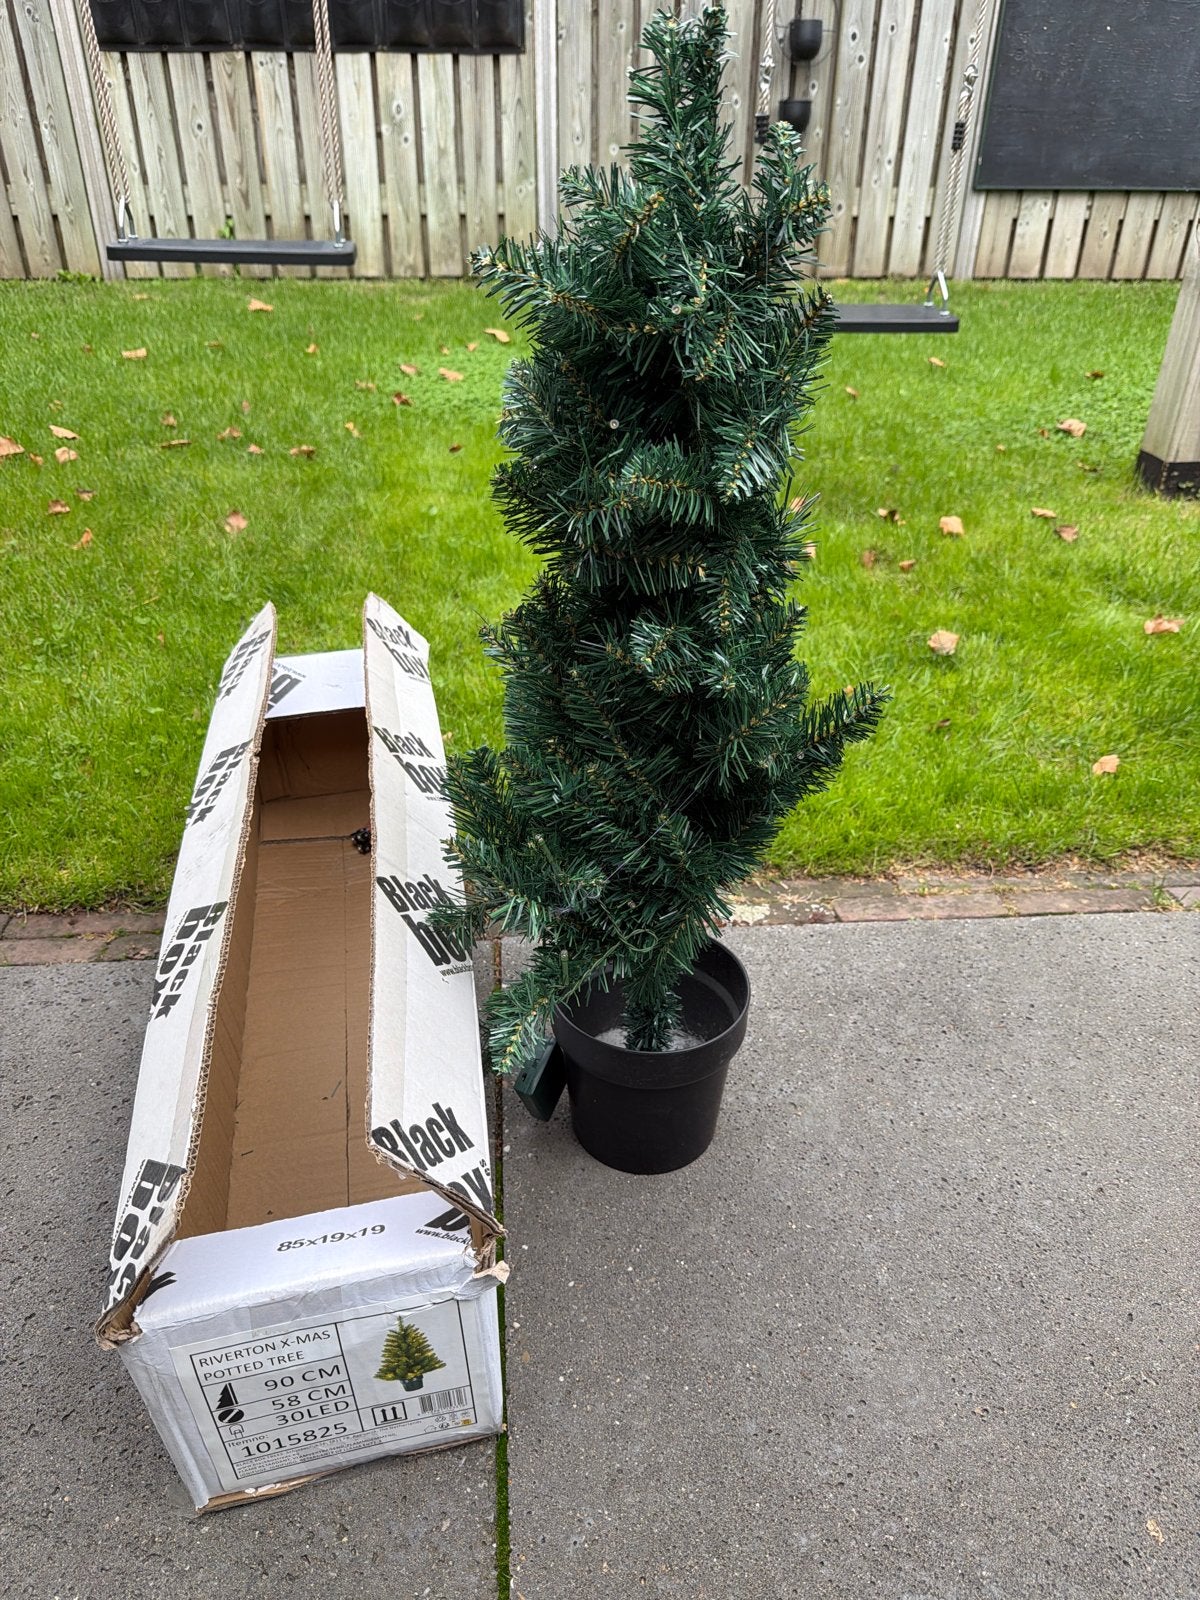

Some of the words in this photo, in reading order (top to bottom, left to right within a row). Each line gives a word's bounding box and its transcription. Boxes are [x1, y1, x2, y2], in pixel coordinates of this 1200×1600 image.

[366, 617, 418, 651] Black
[221, 629, 272, 700] Black
[372, 726, 436, 759] Black
[191, 738, 253, 826] Black
[376, 874, 457, 913] Black
[400, 913, 472, 967] bo
[153, 901, 229, 1020] Black
[372, 1102, 475, 1171] Black
[113, 1163, 187, 1306] Blac
[277, 1224, 386, 1252] 85x19x19
[199, 1342, 276, 1367] RIVERTON
[281, 1330, 331, 1348] X-MAS
[204, 1361, 264, 1381] POTTED
[267, 1350, 305, 1367] TREE
[264, 1376, 294, 1391] 90
[302, 1364, 341, 1381] CM
[271, 1395, 301, 1410] 58
[308, 1384, 346, 1401] CM
[276, 1400, 350, 1425] 30LED
[228, 1433, 269, 1448] Itemno:
[242, 1422, 348, 1458] 1015825
